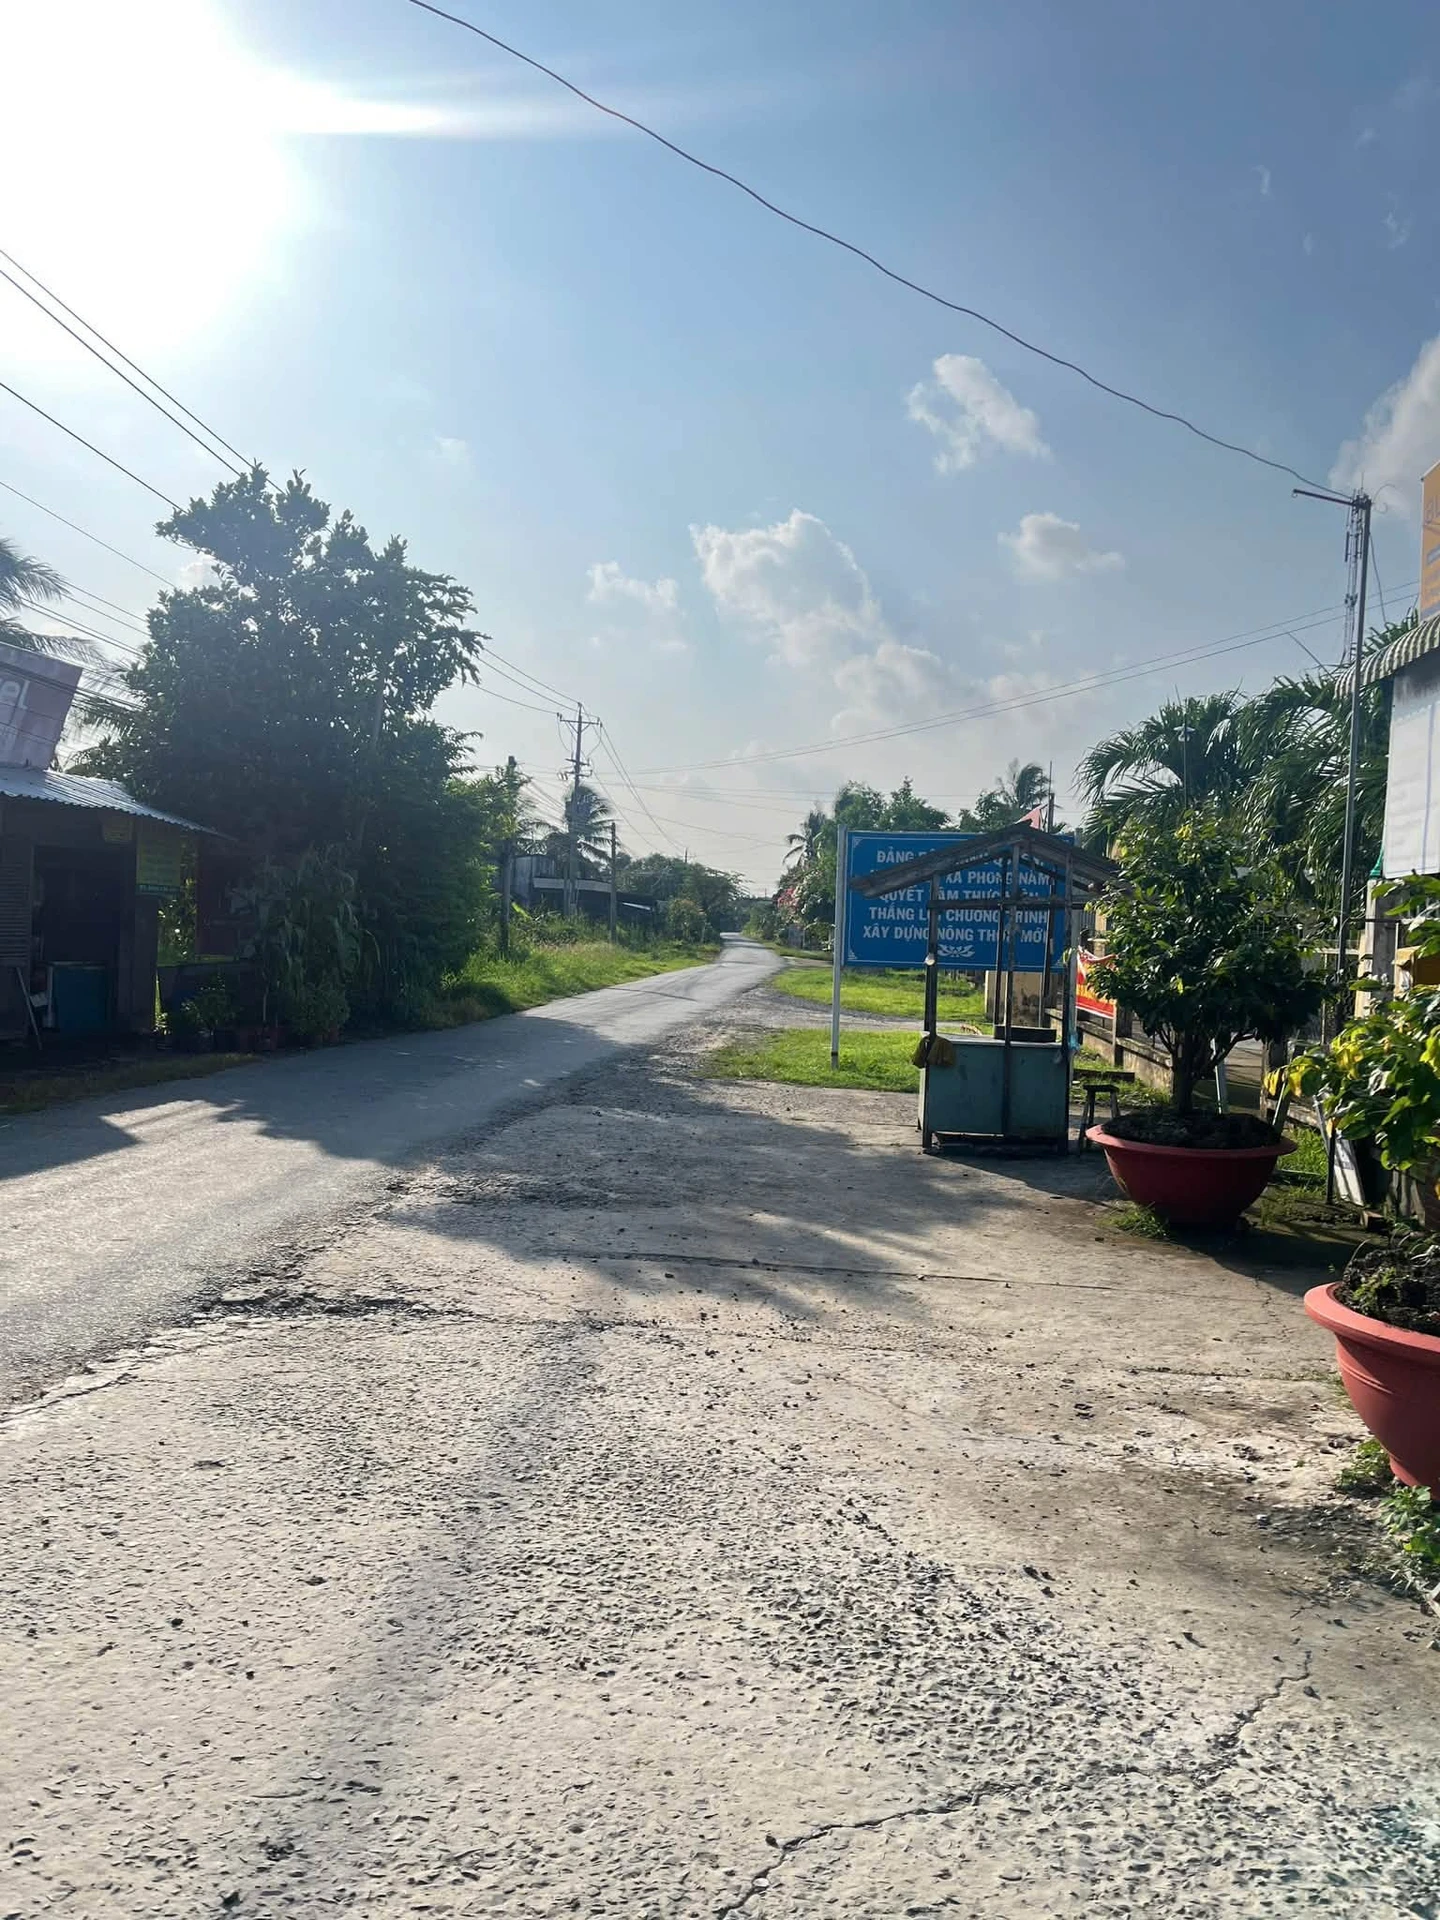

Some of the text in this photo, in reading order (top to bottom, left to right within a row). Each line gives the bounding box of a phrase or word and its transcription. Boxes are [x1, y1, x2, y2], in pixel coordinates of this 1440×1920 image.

[869, 902, 915, 921] THẮNG
[863, 922, 890, 938] XÂY
[937, 924, 974, 941] NÔNG
